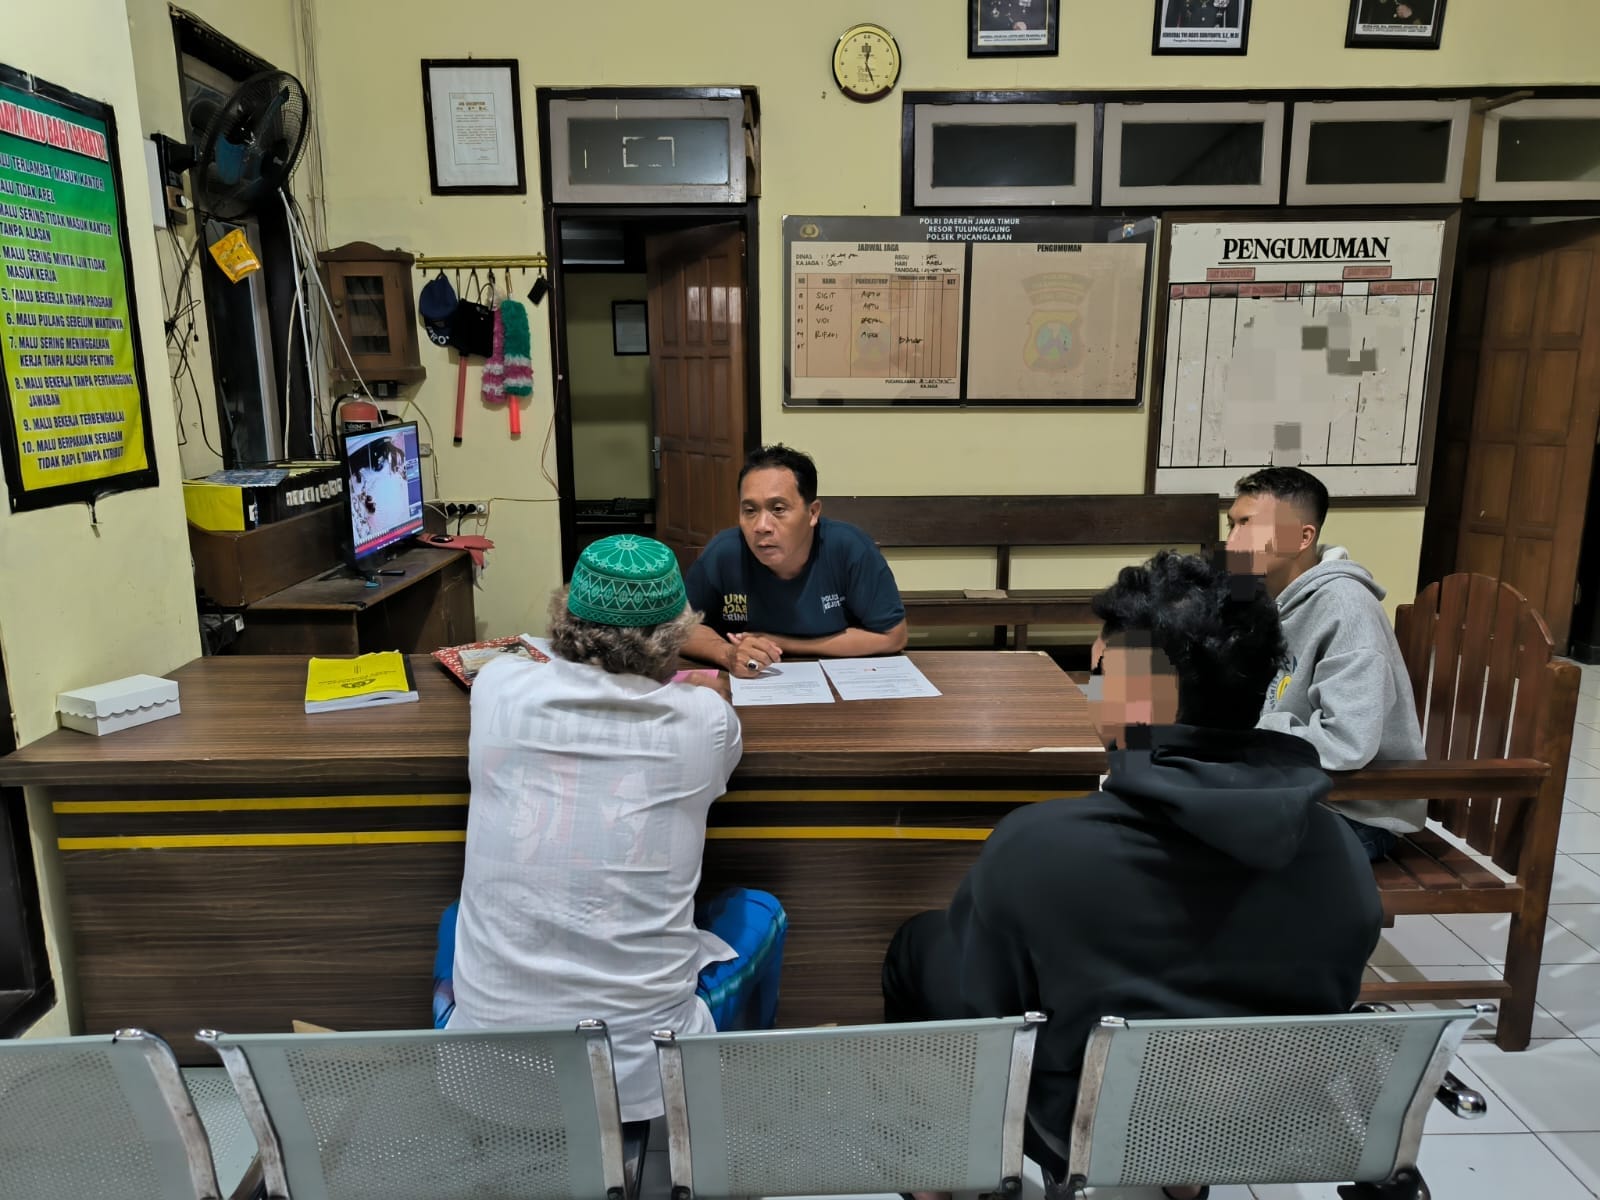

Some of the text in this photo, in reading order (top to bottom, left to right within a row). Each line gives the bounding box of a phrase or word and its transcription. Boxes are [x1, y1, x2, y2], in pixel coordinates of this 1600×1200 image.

[20, 107, 46, 143] MALU
[46, 115, 70, 148] BAGI
[12, 156, 52, 178] TERLAMBAT
[54, 167, 78, 184] MASUK
[80, 173, 104, 190] KANTOR
[16, 183, 37, 198] TIDAK
[38, 187, 55, 202] APEL
[20, 207, 45, 223] SERING
[46, 212, 65, 226] TIDAK
[66, 216, 88, 231] MASUK
[89, 220, 112, 236] KANTOR
[919, 217, 1020, 225] POLRI DAERAH JAWA TIMUR
[928, 225, 1011, 233] RESOR TULUNGAGUNG
[0, 222, 51, 242] TANPA ALASAN
[926, 233, 1013, 241] POLSEK PUCANGLABAN
[857, 243, 899, 252] JADWAL JAGA
[1037, 243, 1082, 253] PENGUMUMAN
[1223, 237, 1390, 260] PENGUMUMAN
[3, 246, 25, 260] MALU
[27, 249, 52, 264] SERING
[53, 252, 75, 267] MINTA
[87, 258, 106, 271] TIDAK
[6, 265, 57, 282] MASUK KERJA
[12, 289, 33, 302] MALU
[35, 291, 64, 304] BEKERJA
[65, 293, 85, 306] TANPA
[86, 296, 113, 308] PROGRAM
[6, 313, 15, 325] 6.
[16, 313, 36, 326] MALU
[39, 314, 65, 327] PULANG
[66, 317, 93, 328] SEBELUM
[9, 336, 110, 350] 7. MALU SERING MENINGGALKAN
[20, 354, 114, 367] KERJA TANPA ALASAN PENTING
[24, 377, 43, 389] MALU
[45, 376, 73, 388] BEKERJA
[74, 375, 94, 387] TANPA
[94, 374, 133, 386] PERTANGGUNG
[29, 394, 60, 407] JAWABAN
[23, 411, 125, 431] 9. MALU BEKERJA TERBENGKALAI
[22, 441, 35, 454] 10.
[37, 438, 57, 452] MALU
[94, 431, 123, 444] SERAGAM
[38, 456, 61, 470] TIDAK
[62, 454, 77, 467] RAPI
[82, 450, 102, 463] TANPA
